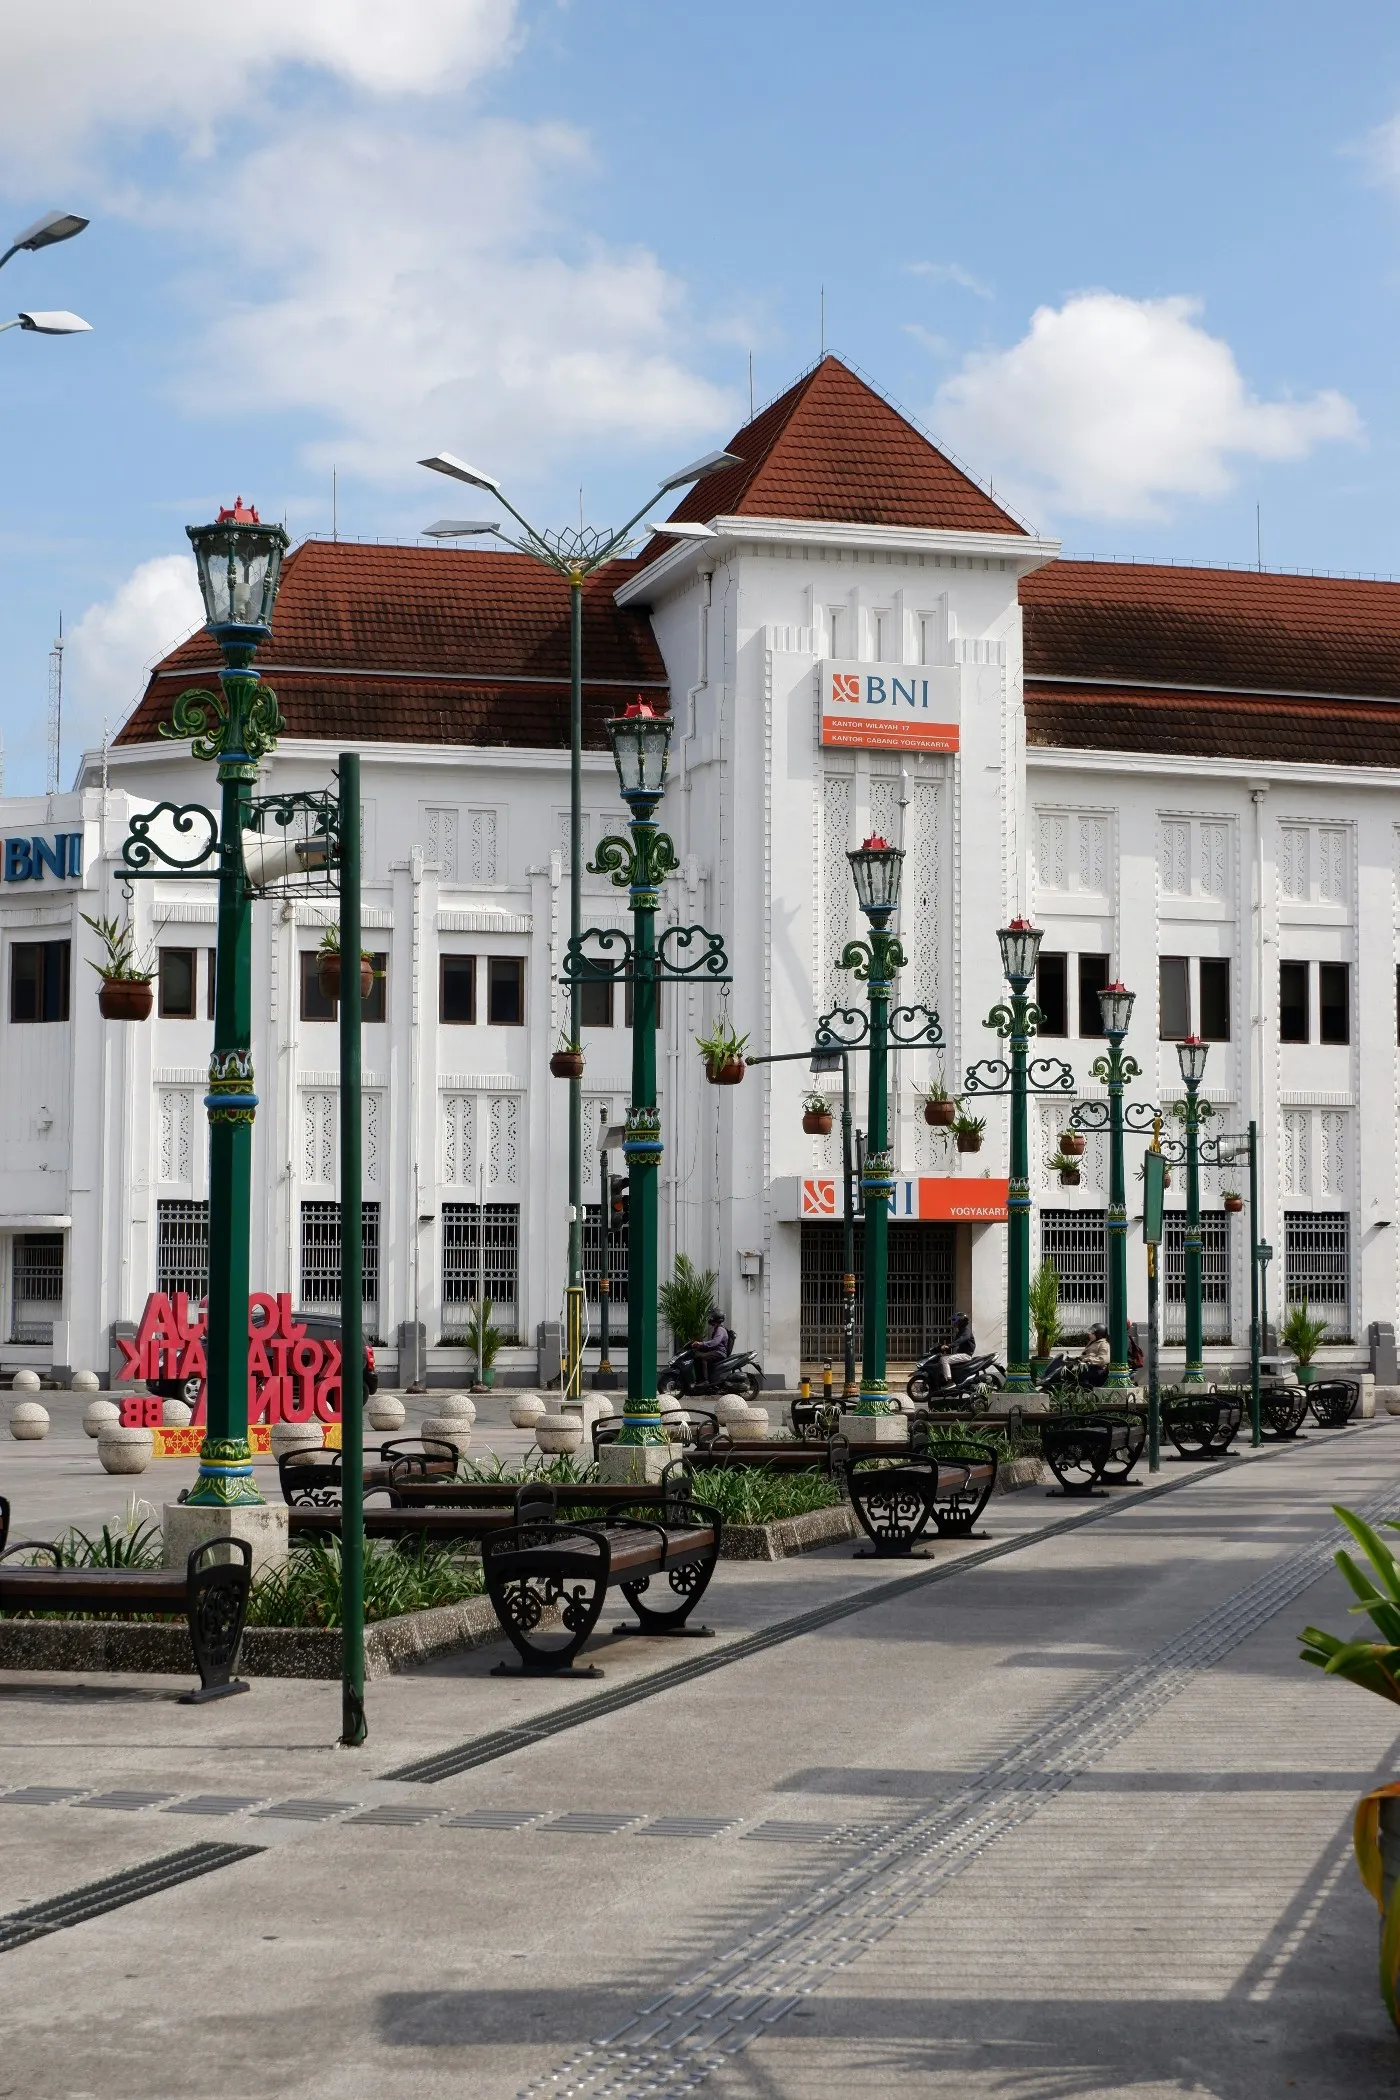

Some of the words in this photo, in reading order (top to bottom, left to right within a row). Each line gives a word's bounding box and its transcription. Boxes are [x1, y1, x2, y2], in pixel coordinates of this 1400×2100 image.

[866, 676, 928, 708] BNI
[832, 720, 863, 728] KANTOR
[865, 722, 898, 731] WILAYAH
[832, 735, 863, 743] KANTOR
[866, 737, 898, 745] CABANG
[900, 739, 950, 748] YOGYAKARTA
[4, 833, 83, 882] BNI
